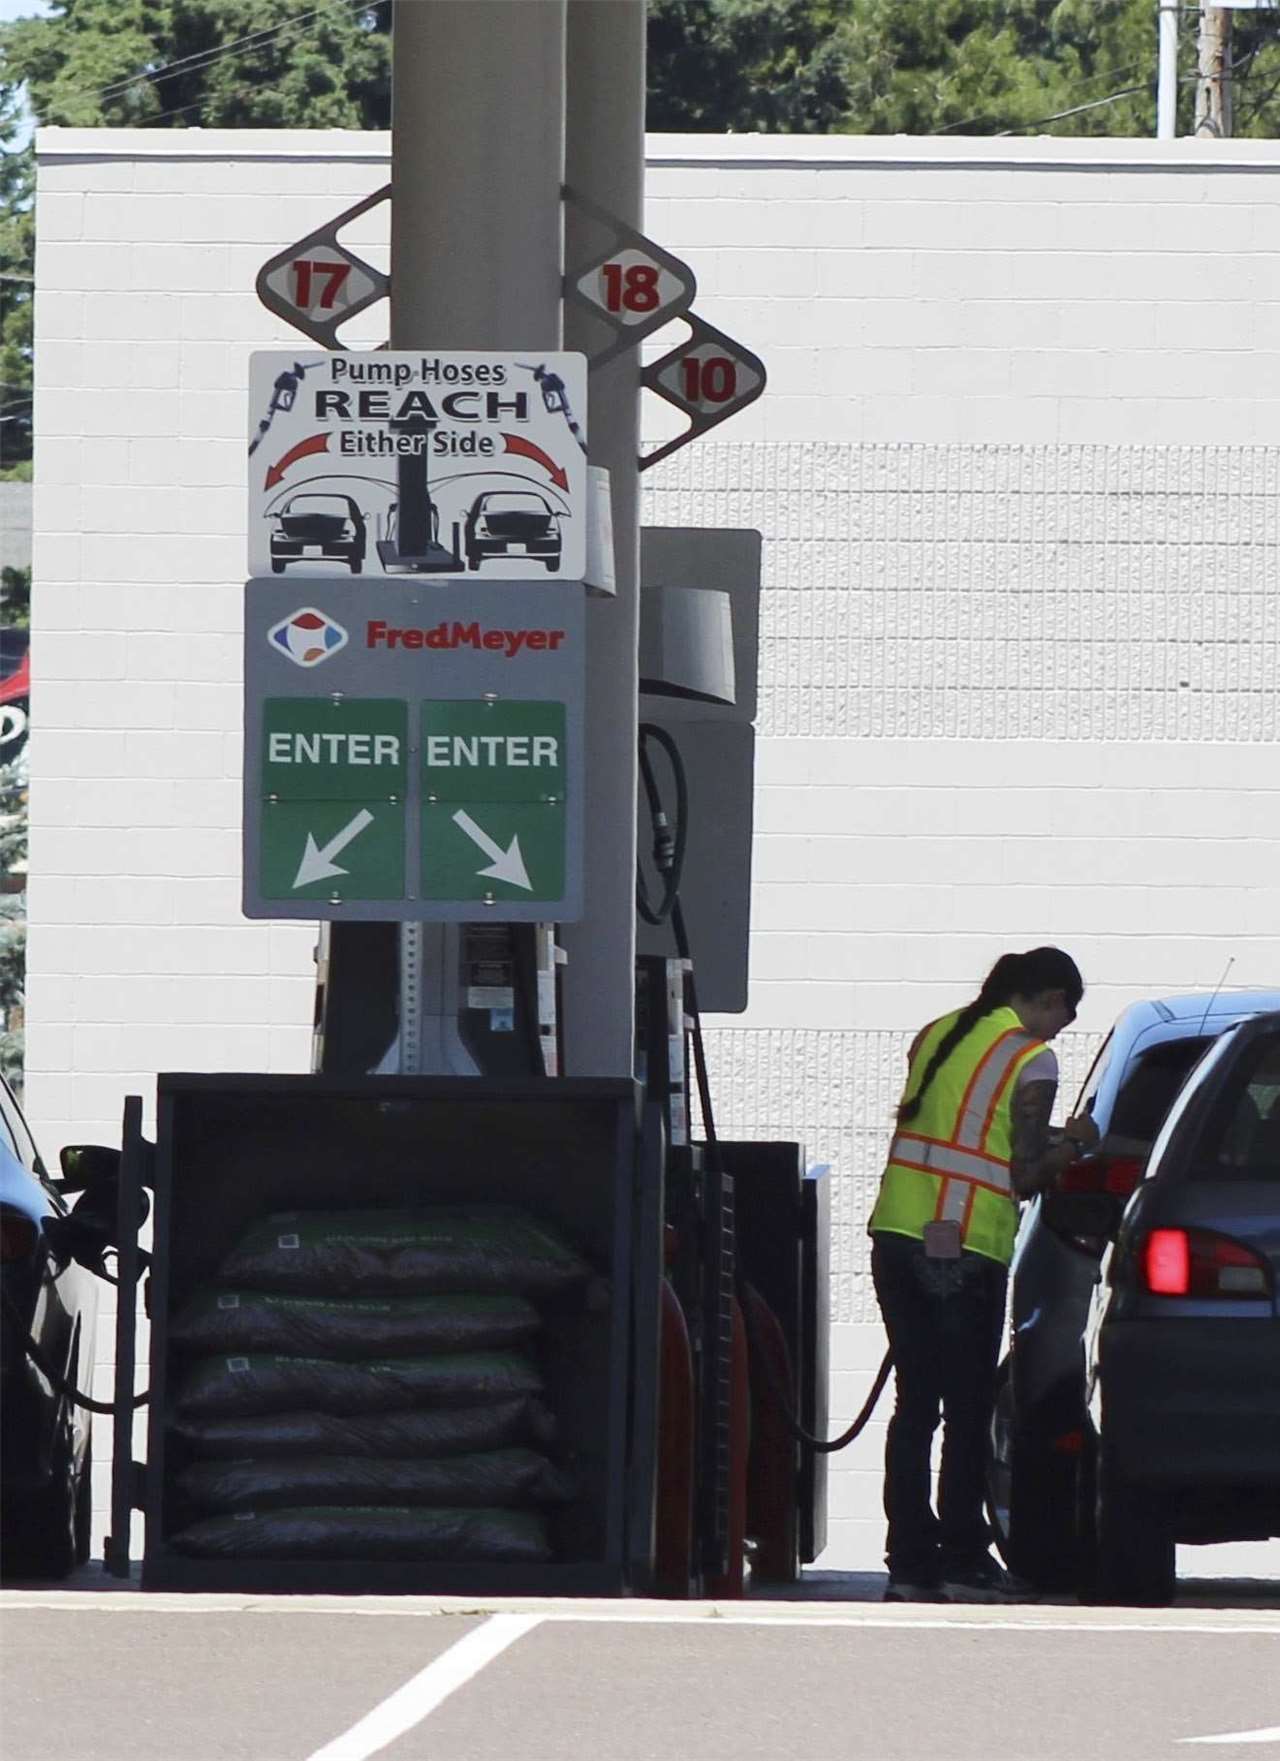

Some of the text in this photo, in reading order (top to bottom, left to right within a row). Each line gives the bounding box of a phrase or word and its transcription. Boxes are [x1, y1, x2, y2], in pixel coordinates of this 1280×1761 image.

[292, 260, 351, 309] 17
[602, 264, 660, 312] 18
[331, 357, 506, 389] Pump Hoses
[682, 356, 737, 403] 10
[314, 390, 530, 422] REACH
[340, 430, 495, 456] Either Side
[366, 620, 565, 657] FredMeyer
[268, 732, 400, 766] ENTER
[426, 735, 559, 768] ENTER
